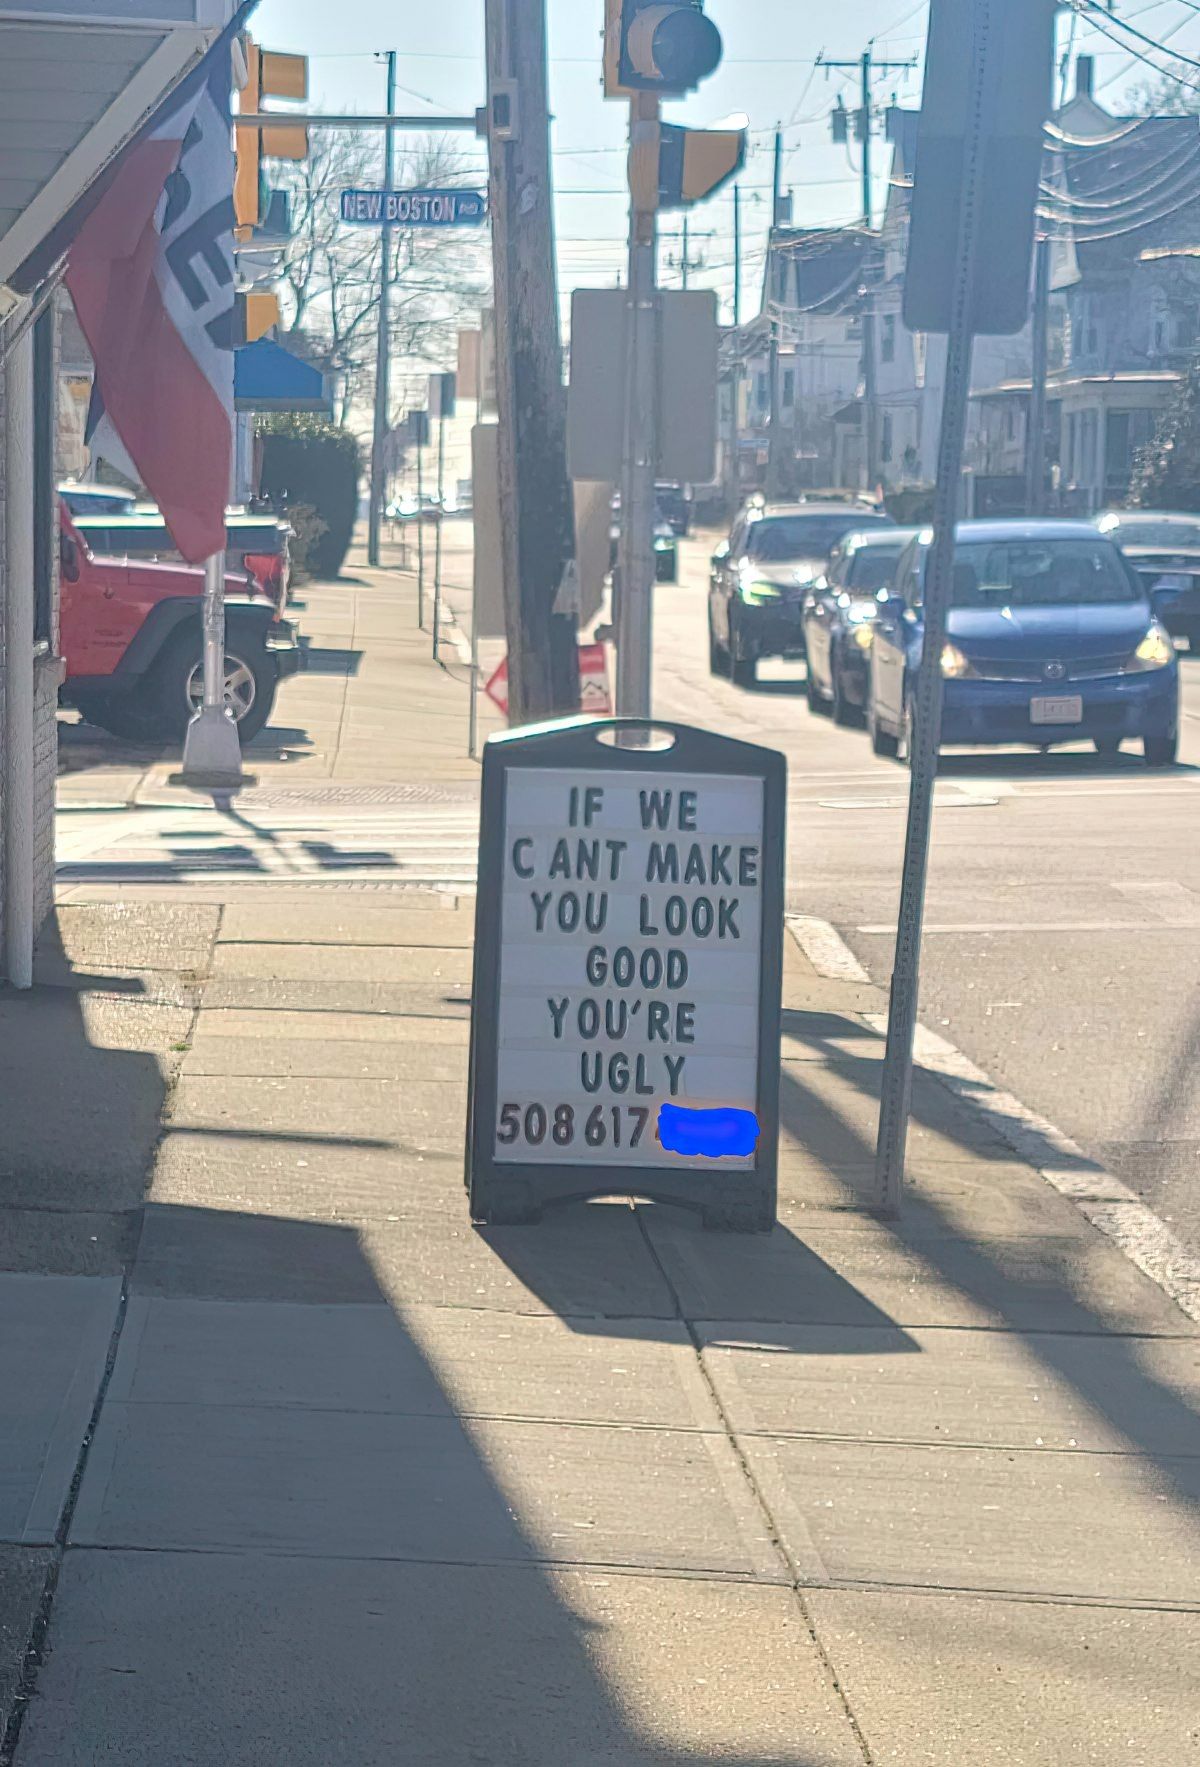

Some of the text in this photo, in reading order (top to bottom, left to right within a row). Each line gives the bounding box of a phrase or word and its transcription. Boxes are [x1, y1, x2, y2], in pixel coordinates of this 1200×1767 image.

[344, 193, 382, 219] NEW
[386, 195, 456, 222] BOSTON
[569, 786, 698, 831] IF WE
[512, 837, 759, 887] CANT MAKE
[530, 890, 741, 939] YOU LOOK
[586, 945, 689, 990] GOOD
[547, 996, 696, 1044] YOU'RE
[581, 1050, 686, 1096] UGLY
[496, 1102, 575, 1146] 508
[584, 1104, 650, 1149] 617
